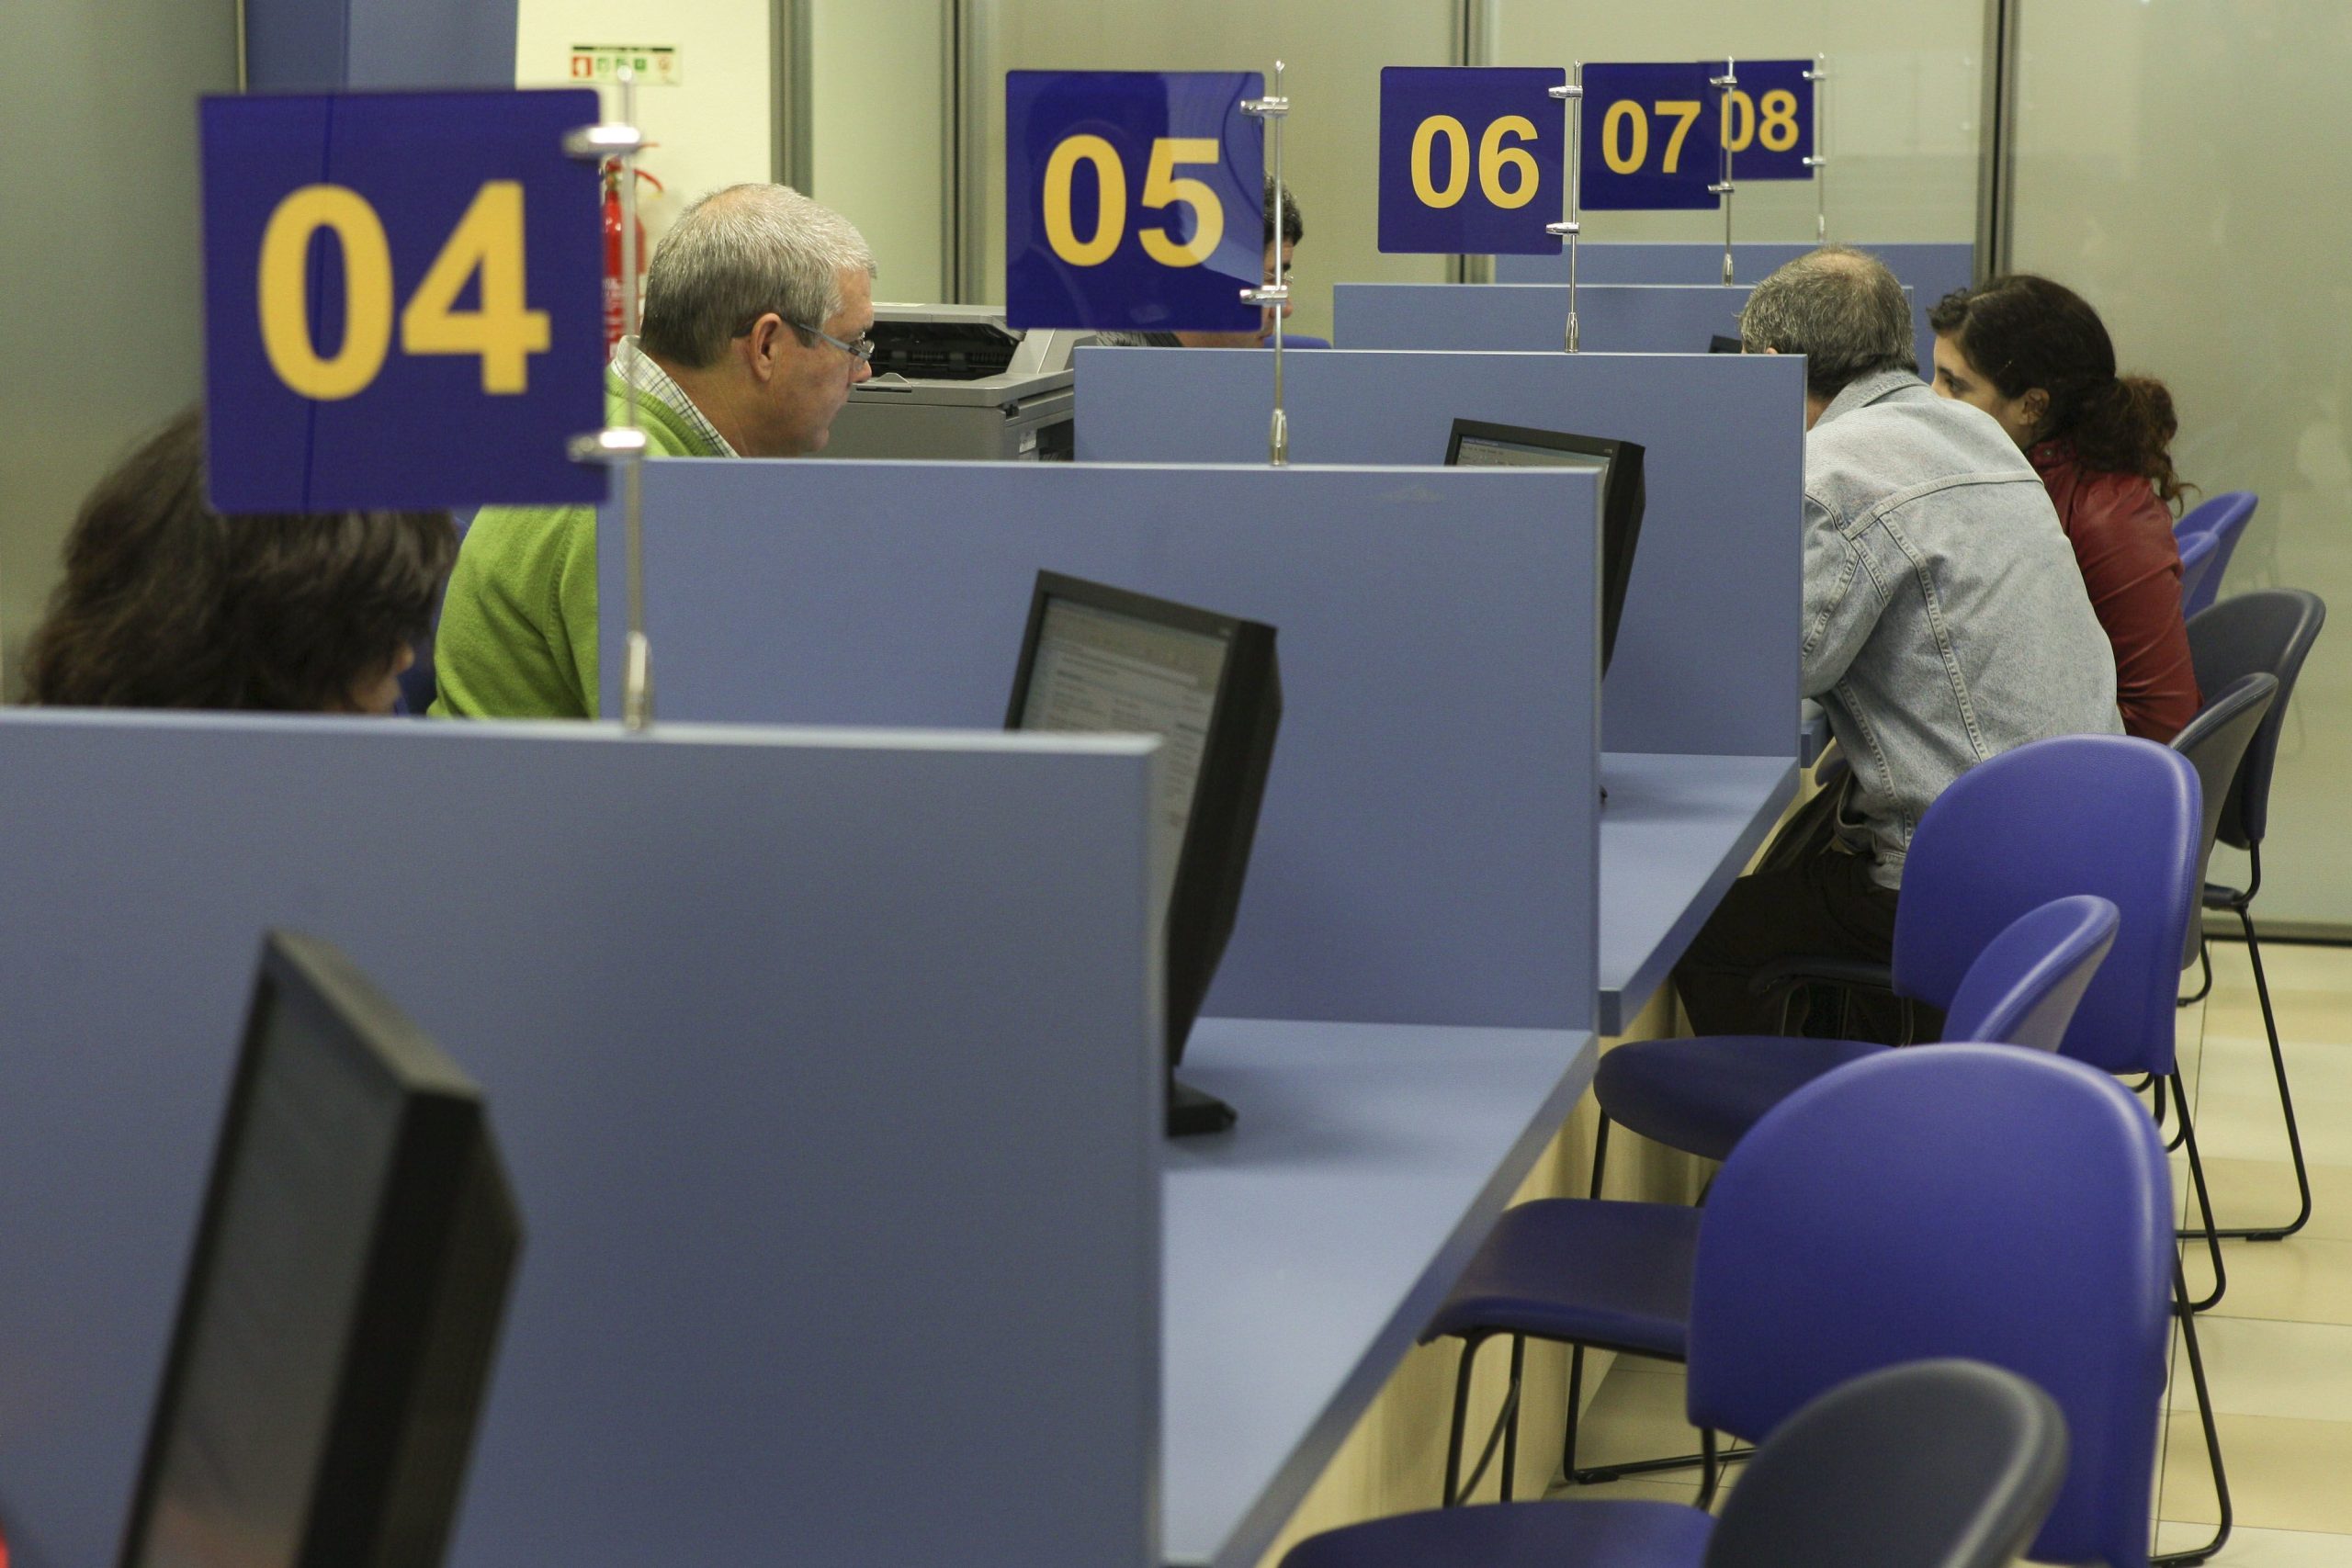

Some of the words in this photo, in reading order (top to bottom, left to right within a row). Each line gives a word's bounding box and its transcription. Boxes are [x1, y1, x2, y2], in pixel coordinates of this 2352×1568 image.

[1410, 114, 1540, 209] 06
[1602, 99, 1702, 175] 07
[1721, 90, 1799, 152] 08
[1043, 134, 1225, 268] 05
[258, 182, 550, 400] 04
